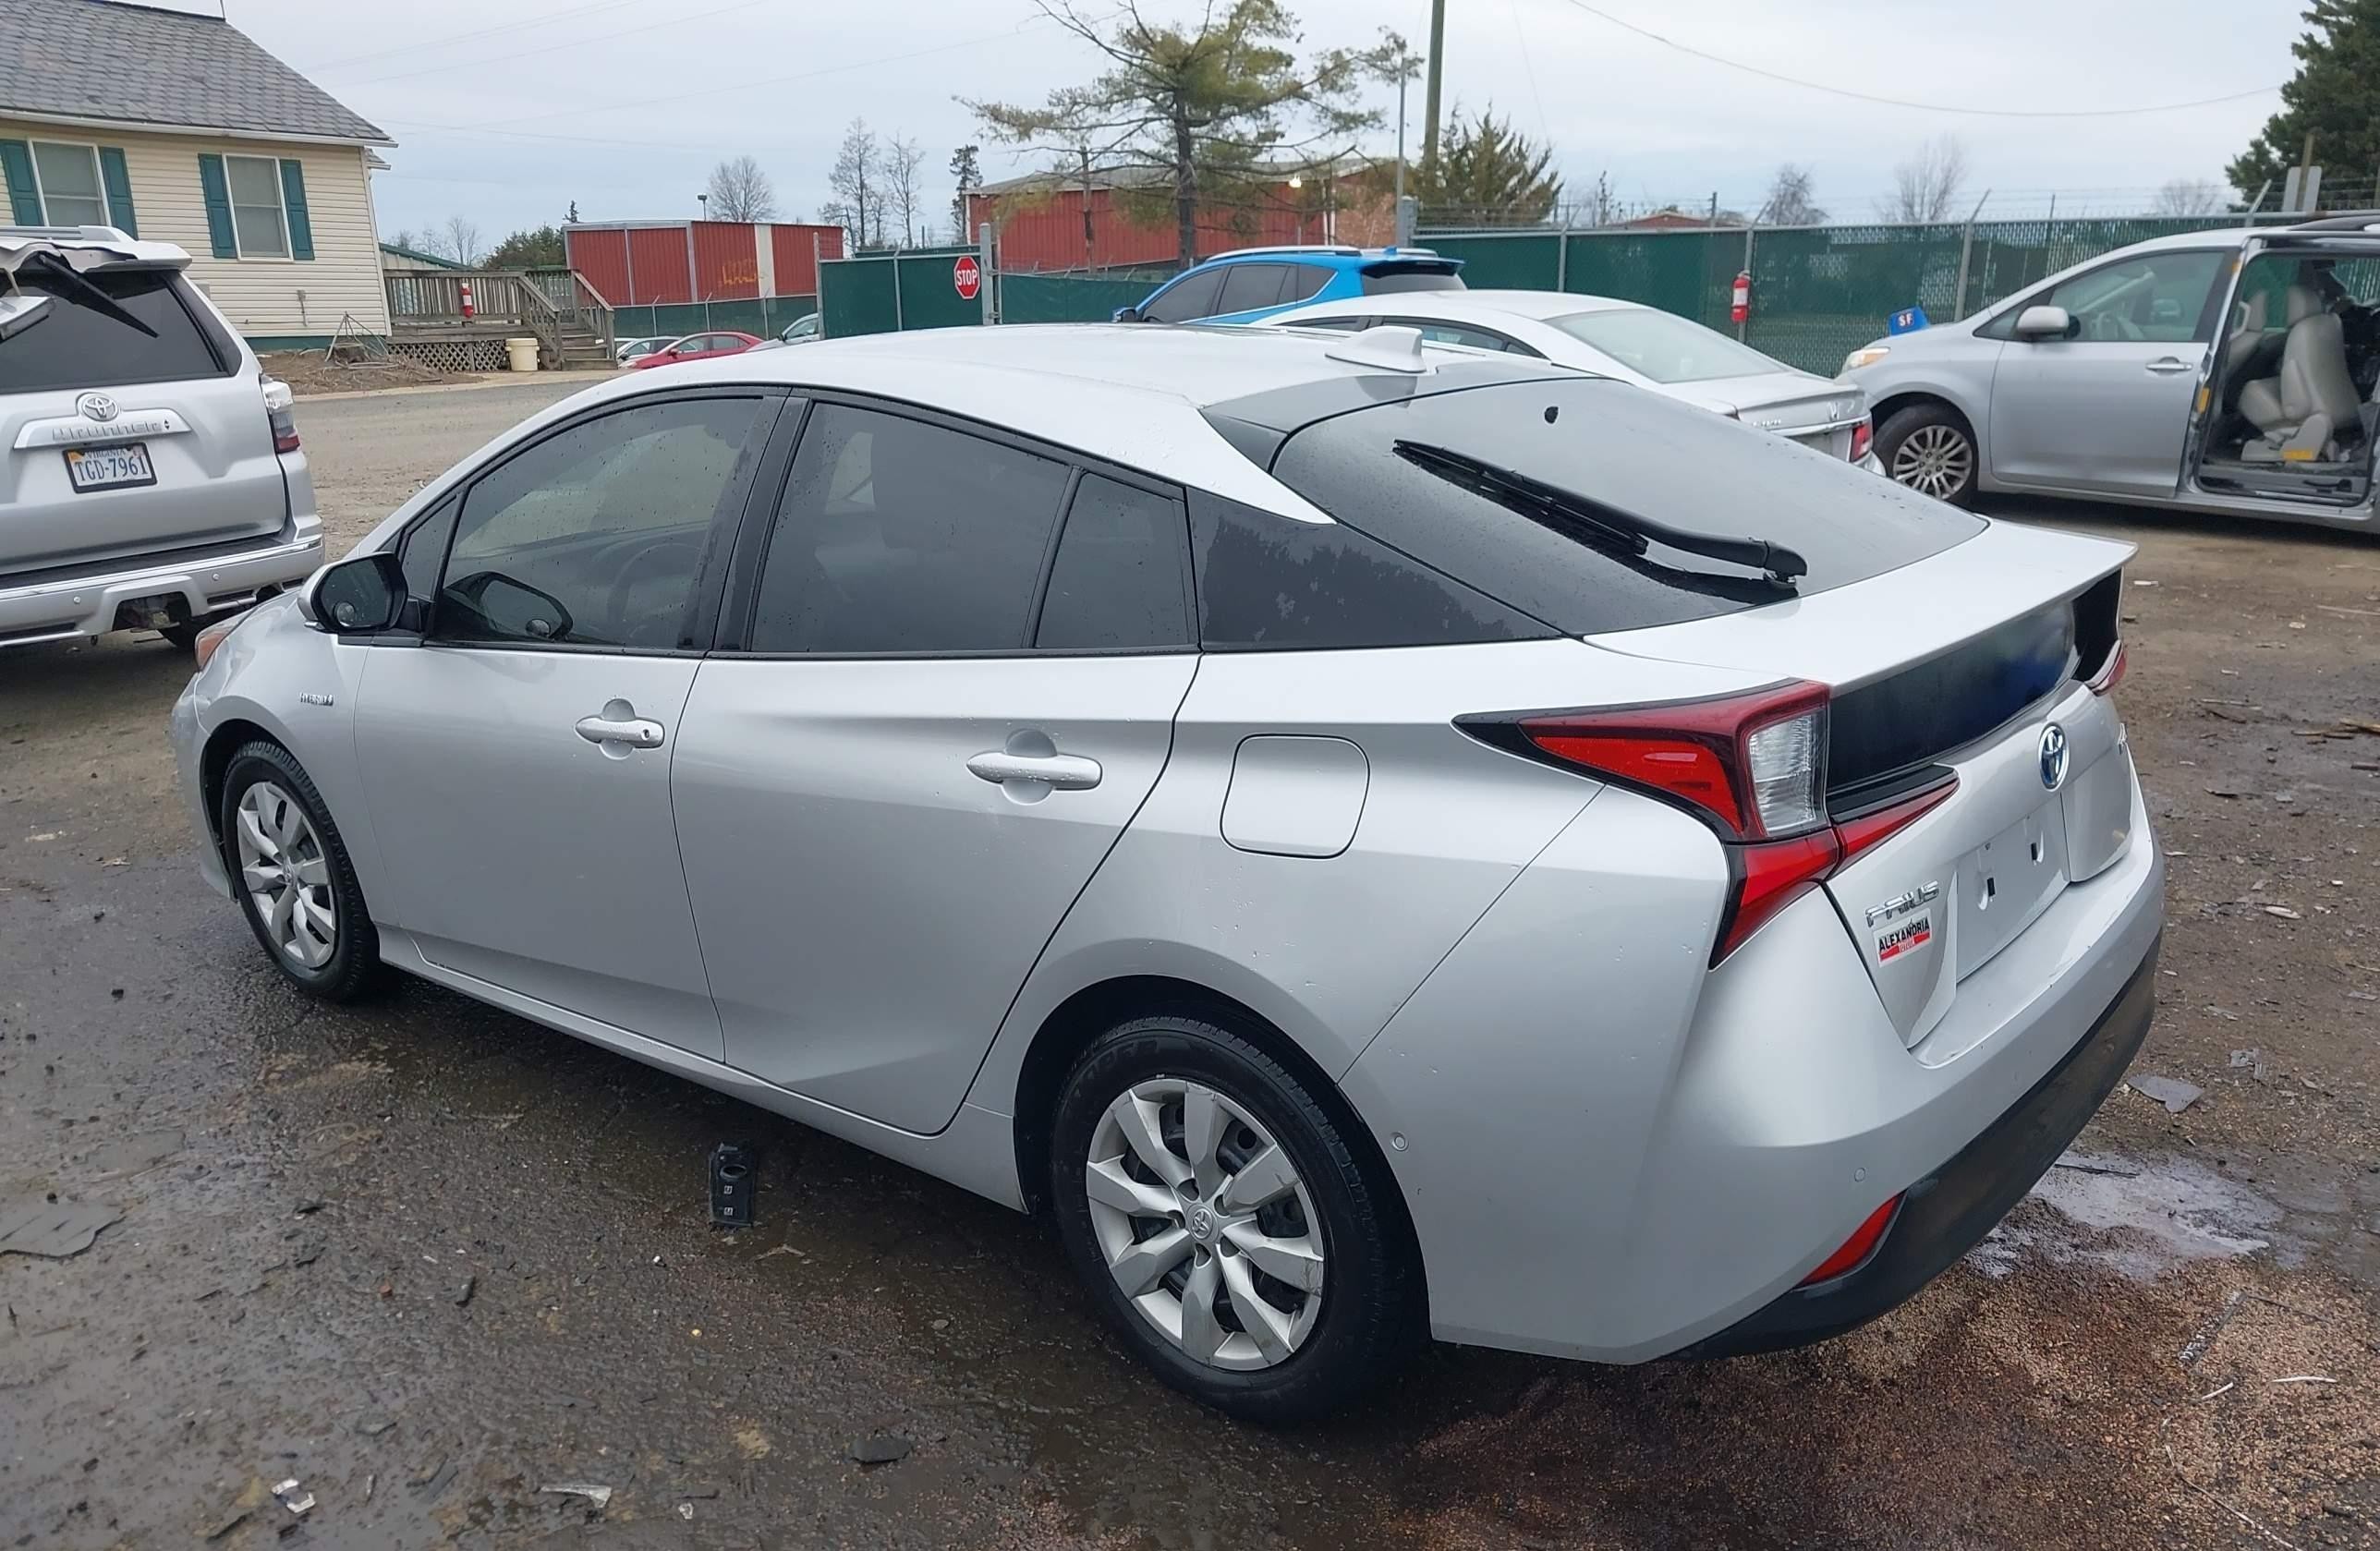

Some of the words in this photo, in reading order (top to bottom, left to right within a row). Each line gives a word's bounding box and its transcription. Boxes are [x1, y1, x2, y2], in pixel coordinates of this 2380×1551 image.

[956, 269, 978, 286] STOP
[87, 448, 127, 459] VIRGINIA
[74, 455, 148, 481] TGD-7961
[1865, 879, 1939, 928] PRIUS
[1878, 915, 1930, 953] ALEXANDRIA
